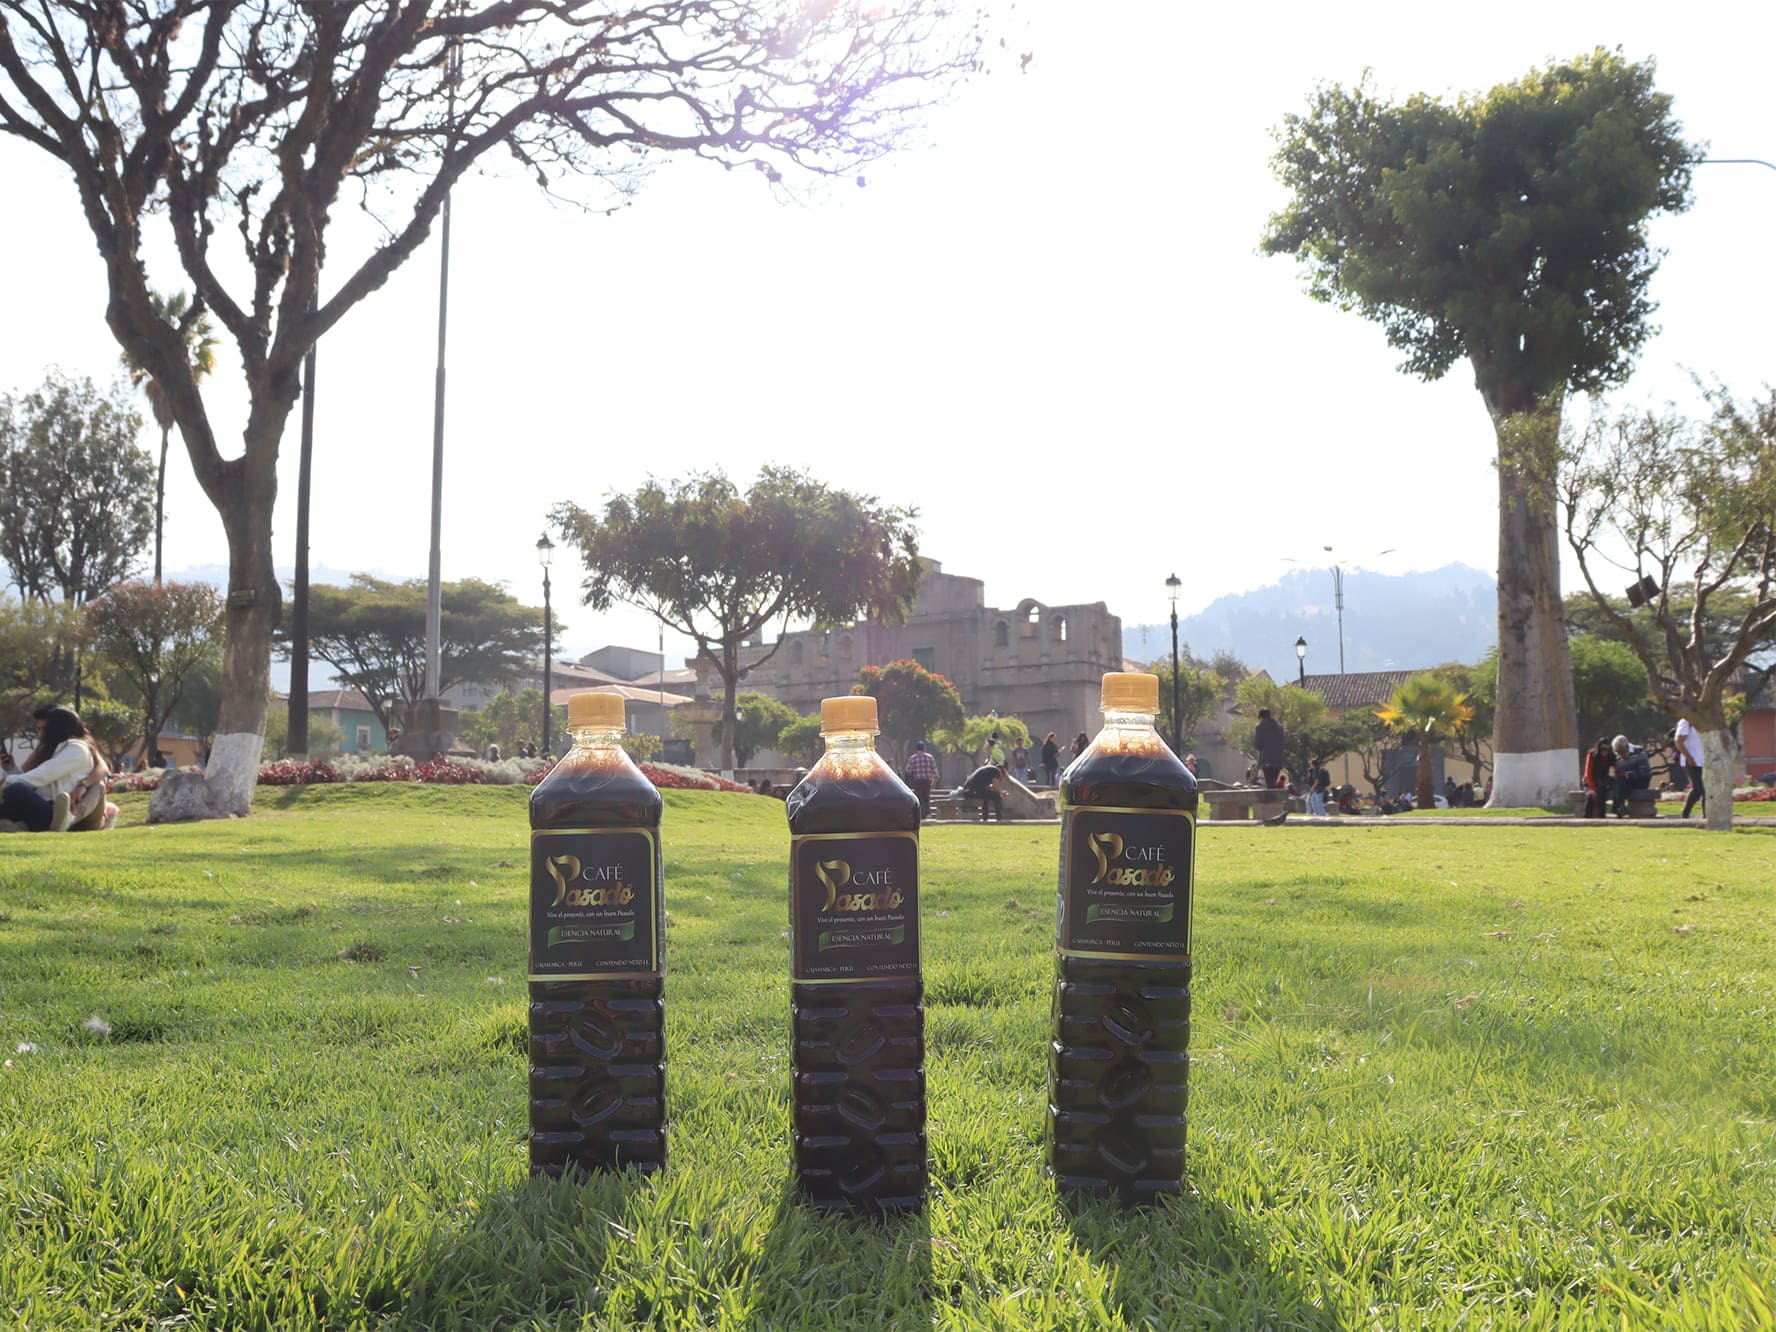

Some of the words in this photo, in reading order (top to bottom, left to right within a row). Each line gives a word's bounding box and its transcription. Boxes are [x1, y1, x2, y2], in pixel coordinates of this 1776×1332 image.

[1088, 832, 1175, 887] Pasado
[1125, 844, 1165, 861] CAFÉ
[546, 854, 635, 907] Pasado
[582, 863, 623, 881] CAFÉ
[853, 868, 893, 885] CAFÉ
[815, 860, 904, 912] Pasado
[1100, 908, 1129, 916] ESENCIA
[1129, 909, 1161, 917] NATURAL
[590, 929, 622, 937] NATURAL
[860, 933, 891, 941] NATURAL
